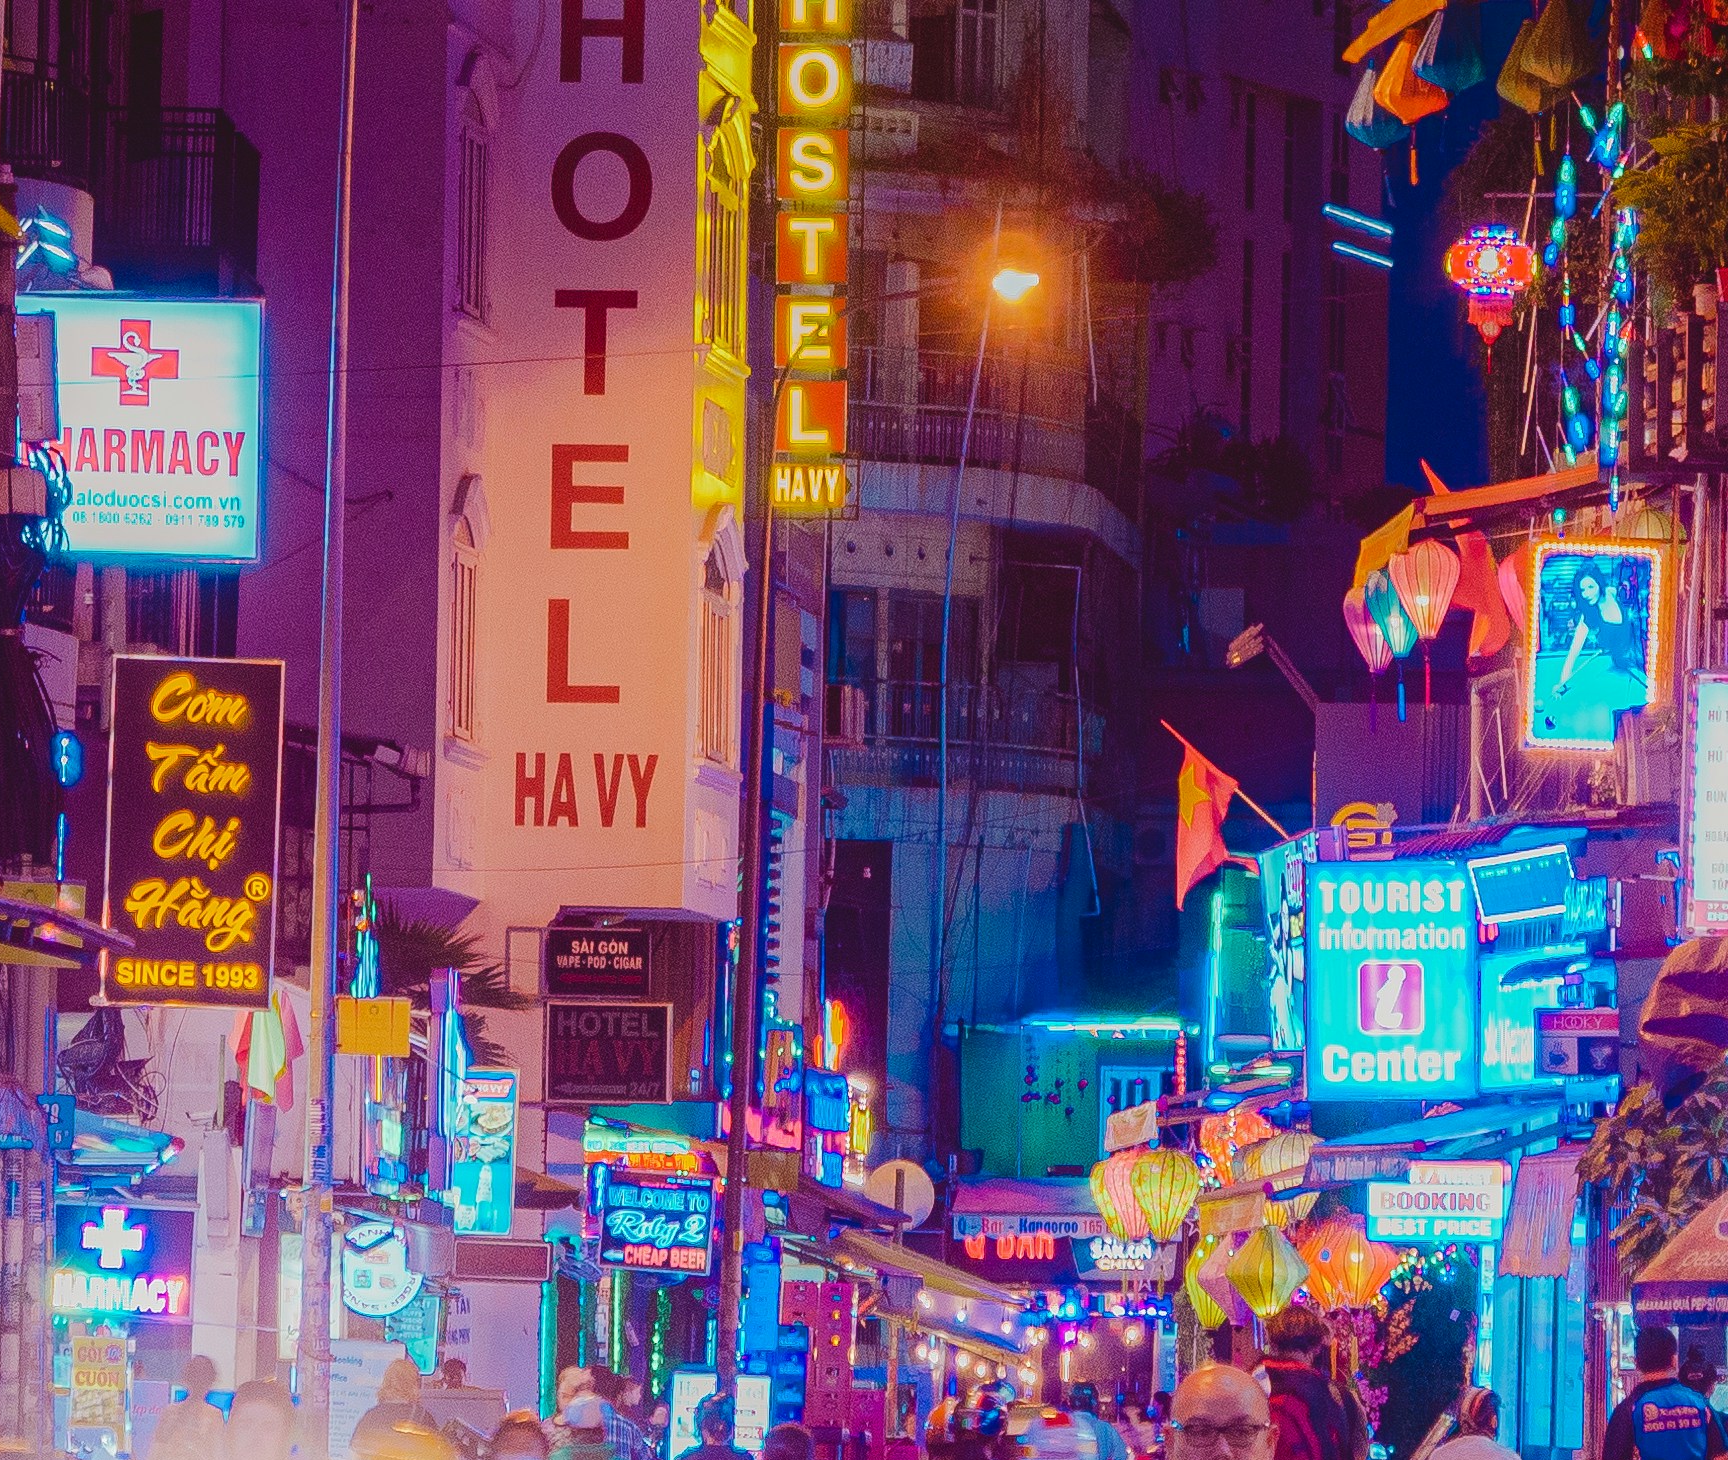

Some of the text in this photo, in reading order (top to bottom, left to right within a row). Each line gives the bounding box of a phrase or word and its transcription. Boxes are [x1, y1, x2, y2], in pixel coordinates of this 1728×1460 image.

[546, 0, 654, 705] HOTEL
[24, 427, 245, 477] HARMACY
[146, 741, 251, 794] Tấm
[153, 809, 241, 871] Chị
[1319, 881, 1466, 914] TOURIST
[1319, 922, 1466, 950] information
[116, 961, 259, 989] SINCE 1993
[557, 956, 580, 969] VAPE
[613, 957, 642, 970] CIGAR
[557, 1010, 659, 1037] HOTEL
[1323, 1045, 1462, 1083] Center
[608, 1185, 709, 1213] WELCOME TO
[1380, 1192, 1491, 1211] BOOKING
[678, 1213, 707, 1243] 2
[1377, 1218, 1492, 1236] BEST PRICE
[624, 1244, 707, 1270] CHEAP BEER
[53, 1273, 183, 1315] HARMACY
